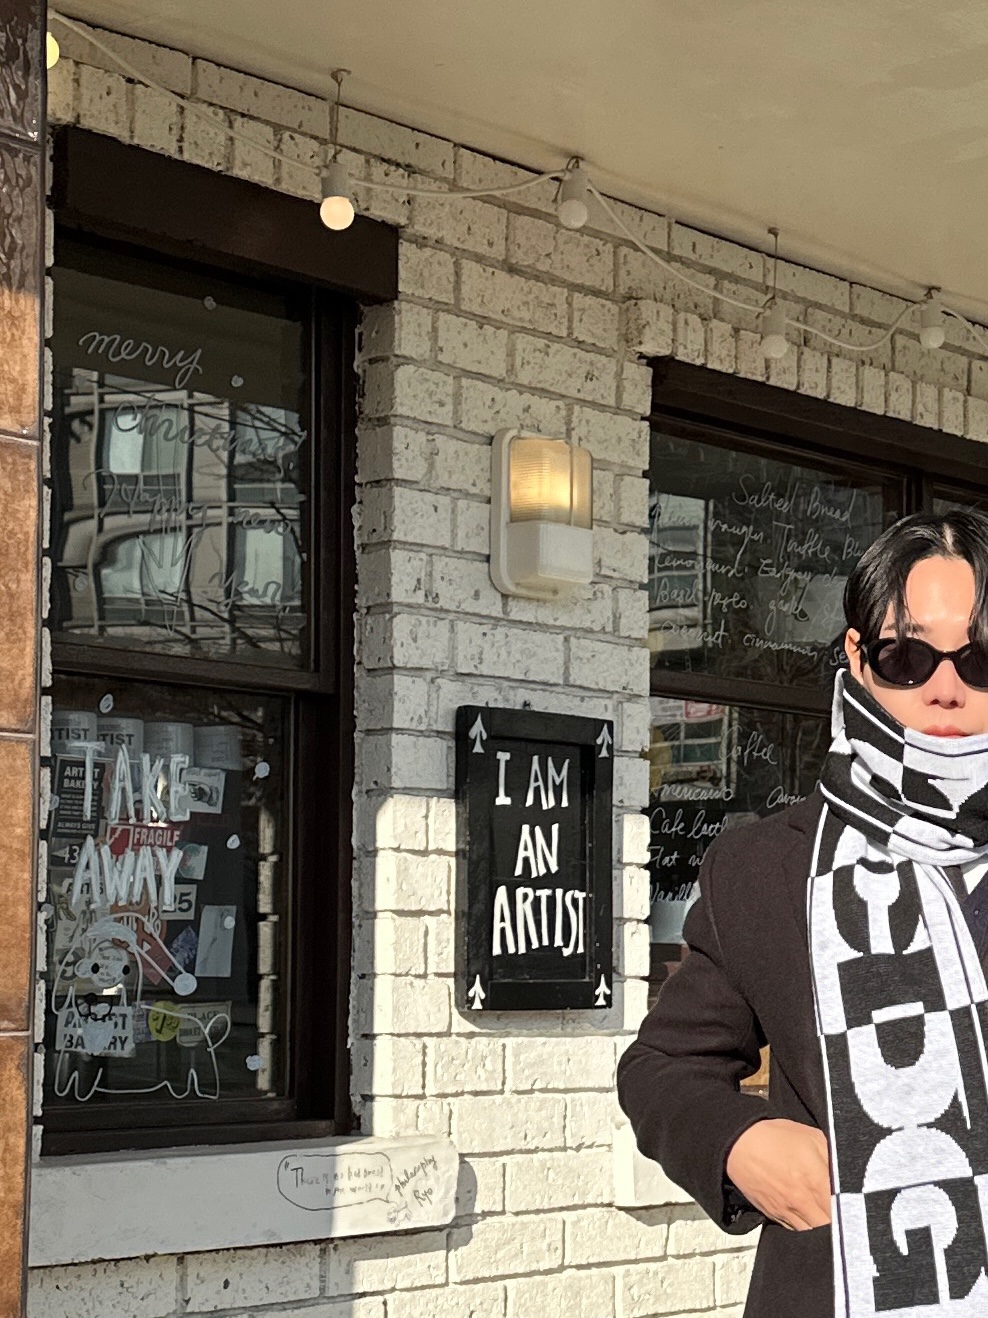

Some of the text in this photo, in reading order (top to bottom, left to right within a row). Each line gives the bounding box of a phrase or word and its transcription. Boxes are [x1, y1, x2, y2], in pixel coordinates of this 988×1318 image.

[78, 331, 202, 389] merry
[732, 474, 799, 514] Salted
[52, 727, 90, 741] TIST
[98, 733, 135, 746] TIST
[63, 778, 99, 790] BAKY
[64, 766, 101, 779] ARTT
[66, 741, 190, 826] TAKE
[495, 751, 570, 810] I AM
[72, 834, 184, 912] AWAY
[514, 823, 559, 878] AN
[492, 885, 586, 957] ARTIST
[63, 1033, 128, 1051] BARY
